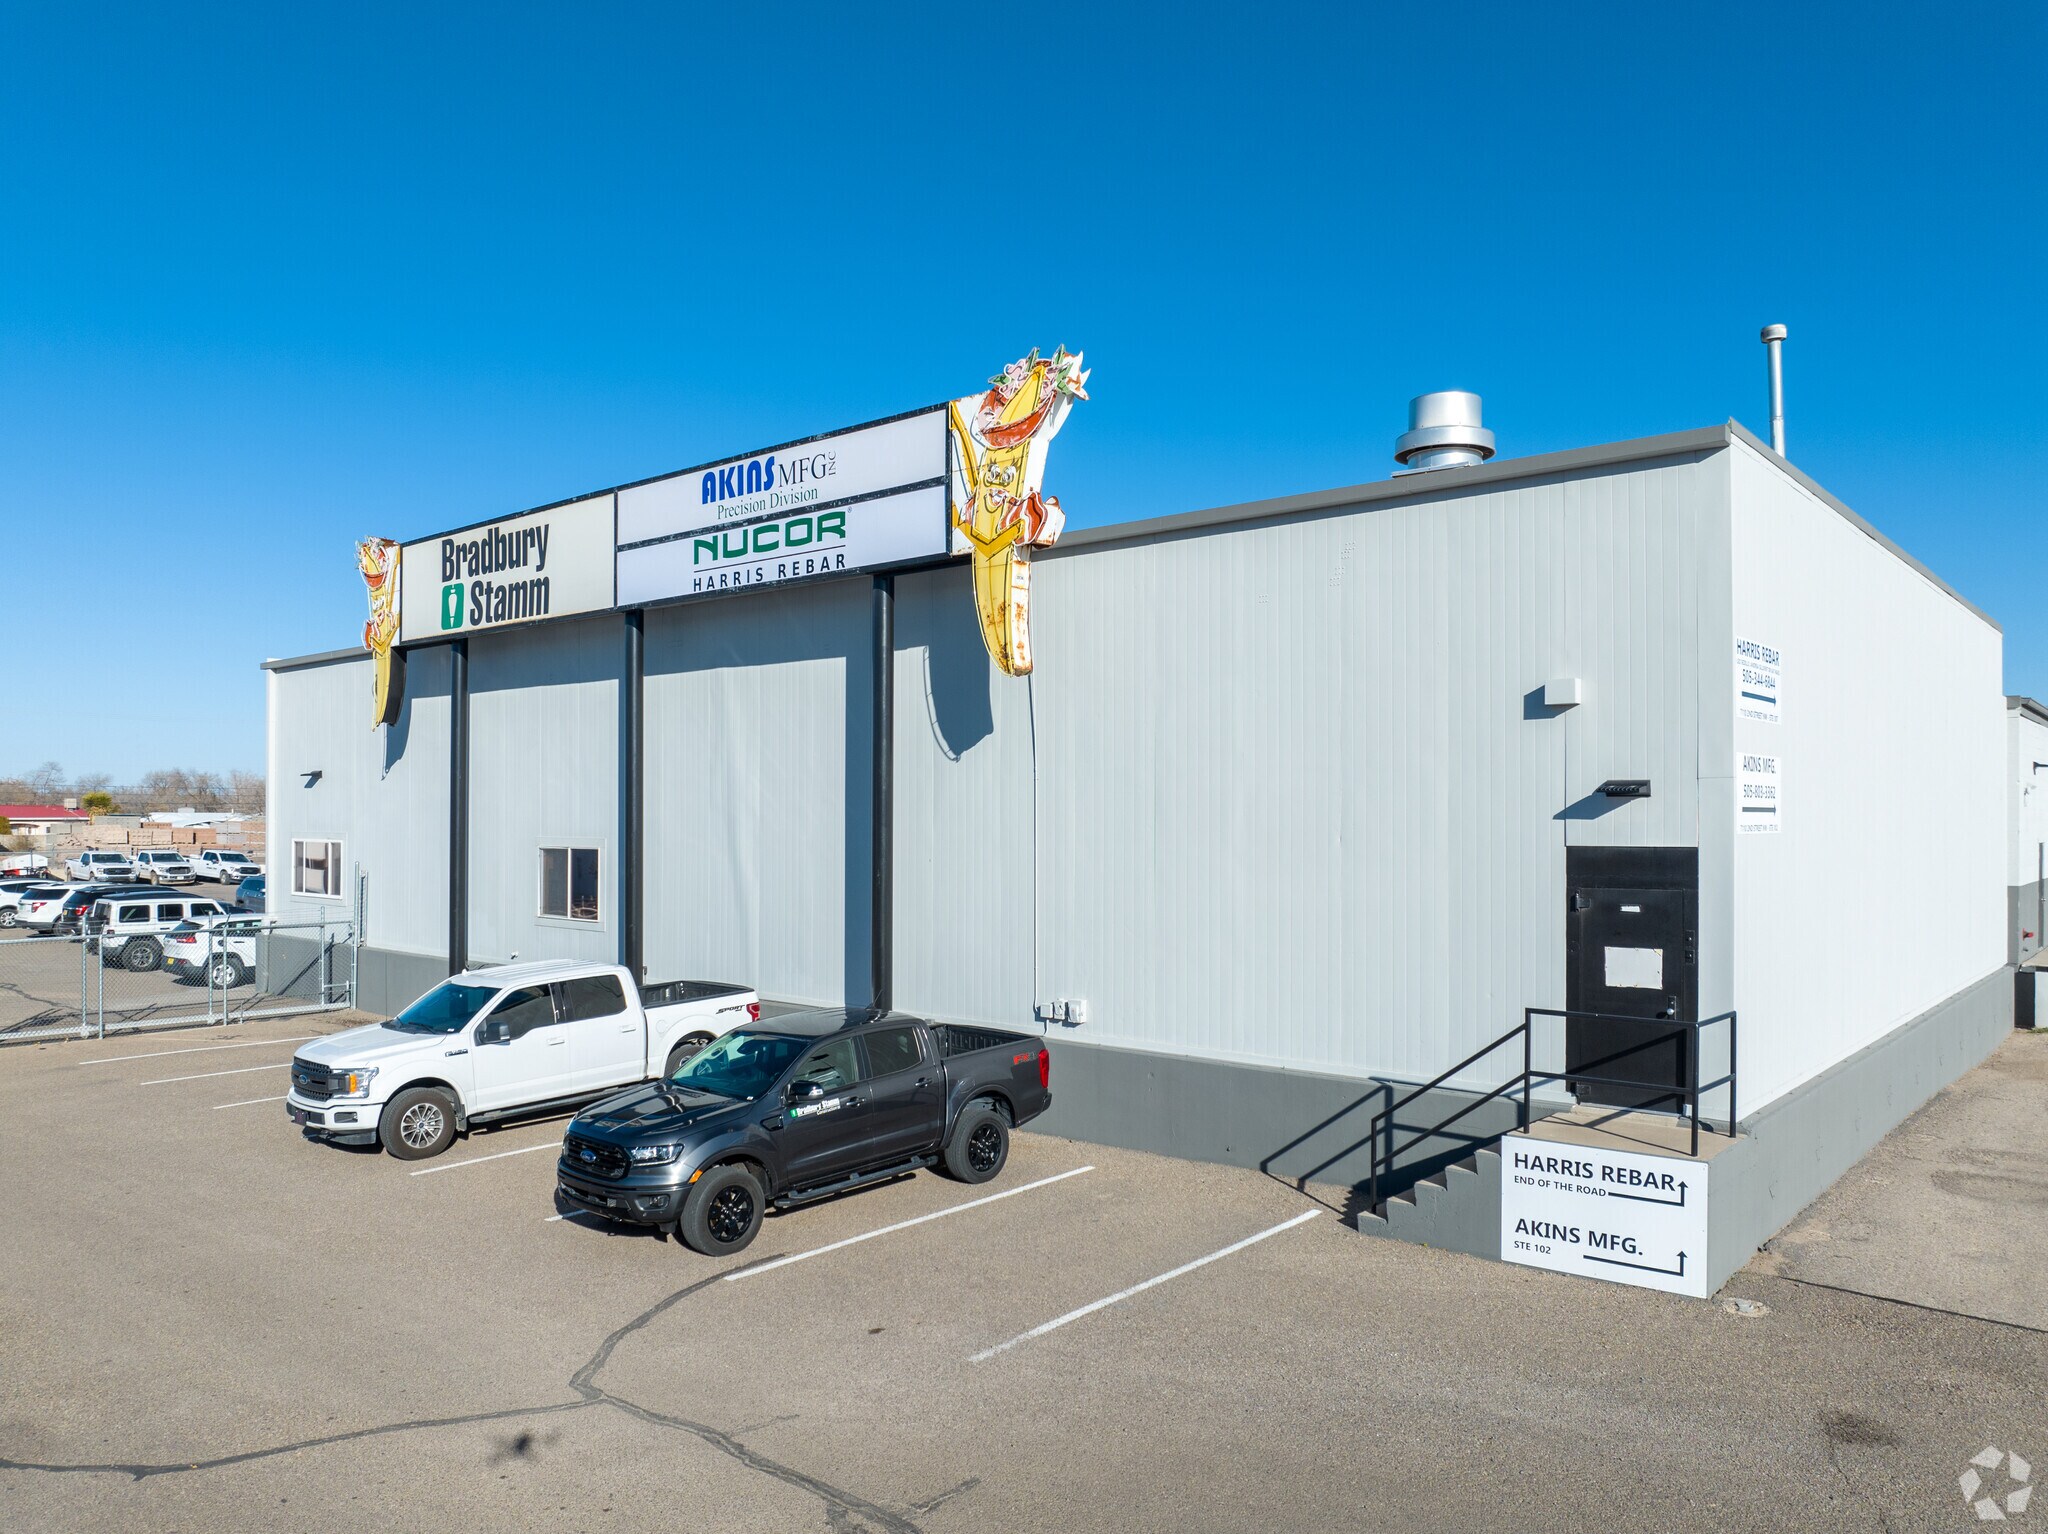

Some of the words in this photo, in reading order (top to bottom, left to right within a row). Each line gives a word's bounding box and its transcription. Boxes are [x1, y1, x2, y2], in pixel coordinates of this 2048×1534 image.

[702, 456, 775, 505] AKINS
[779, 453, 827, 488] MFG
[828, 450, 837, 476] INC
[717, 497, 766, 520] Precision
[770, 486, 818, 509] Division
[441, 523, 550, 583] Bradbury
[693, 511, 846, 566] NUCOR
[693, 567, 763, 592] HARRIS
[778, 553, 846, 578] REBAR
[469, 576, 550, 626] Stamm
[1736, 638, 1760, 660] HARRIS
[1762, 646, 1780, 667] REBAR
[1743, 755, 1761, 773] AKINS
[1762, 757, 1777, 774] MFG.
[1514, 1152, 1594, 1179] HARRIS
[1601, 1164, 1676, 1192] REBAR
[1514, 1175, 1535, 1186] END
[1537, 1179, 1551, 1188] OF
[1553, 1181, 1573, 1192] THE
[1576, 1184, 1607, 1197] ROAD
[1513, 1240, 1531, 1251] STE
[1534, 1243, 1551, 1255] 102
[1514, 1218, 1581, 1244] AKINS
[1588, 1230, 1643, 1256] MFG.
